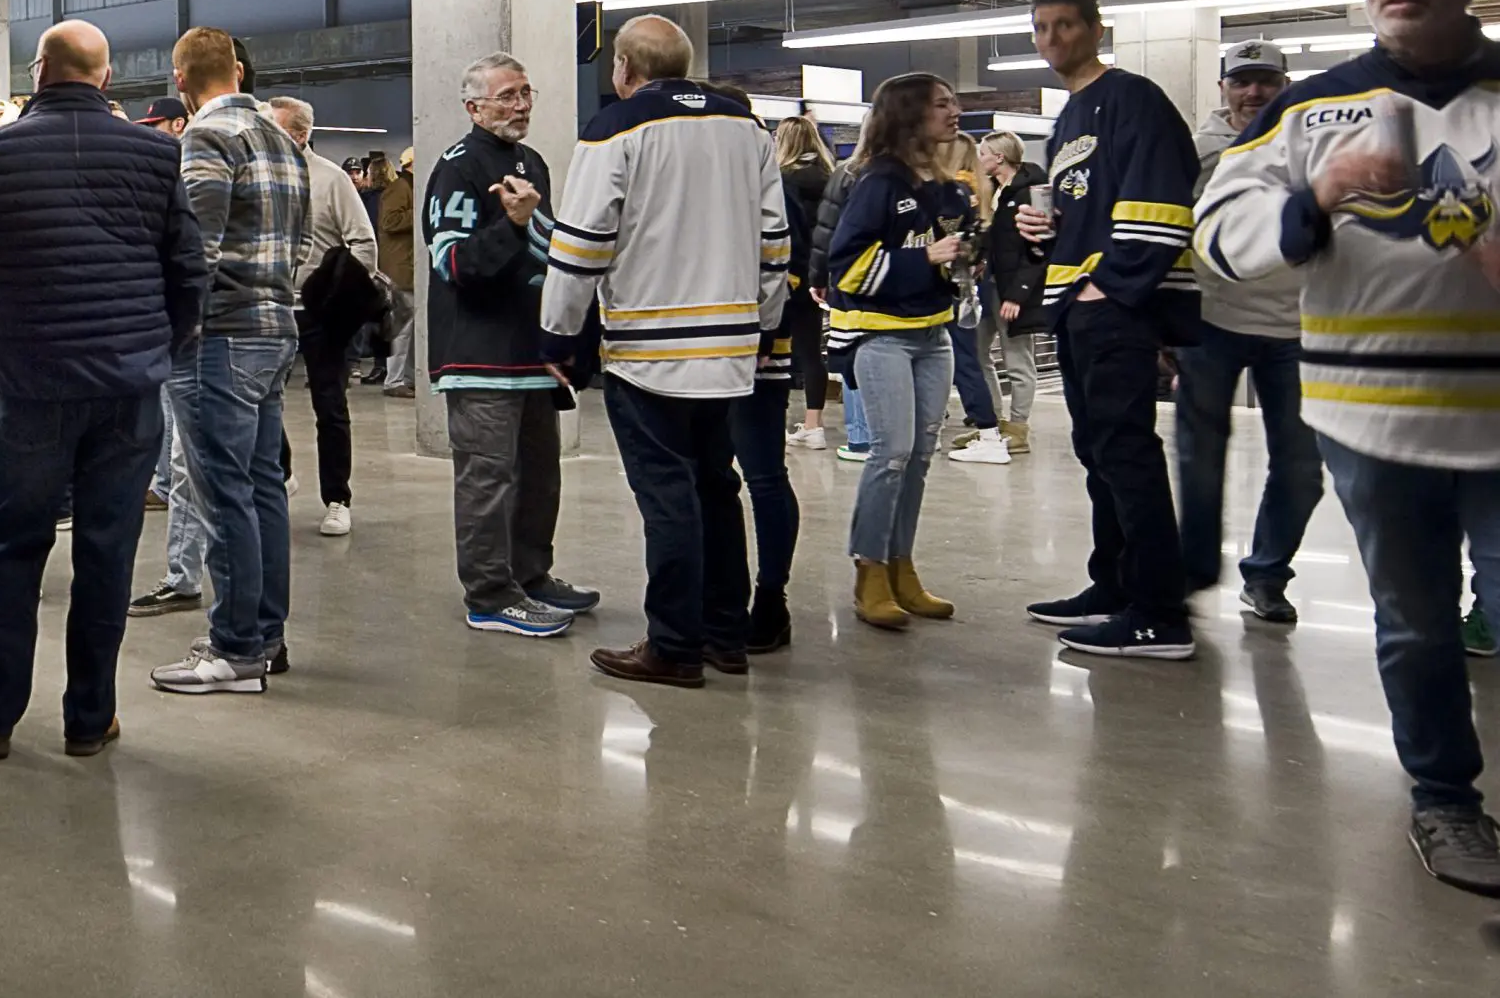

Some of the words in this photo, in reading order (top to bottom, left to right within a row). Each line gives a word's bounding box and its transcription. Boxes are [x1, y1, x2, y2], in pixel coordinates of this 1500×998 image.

[671, 93, 707, 101] CCM
[1305, 107, 1374, 128] CCHA
[428, 190, 478, 230] 44
